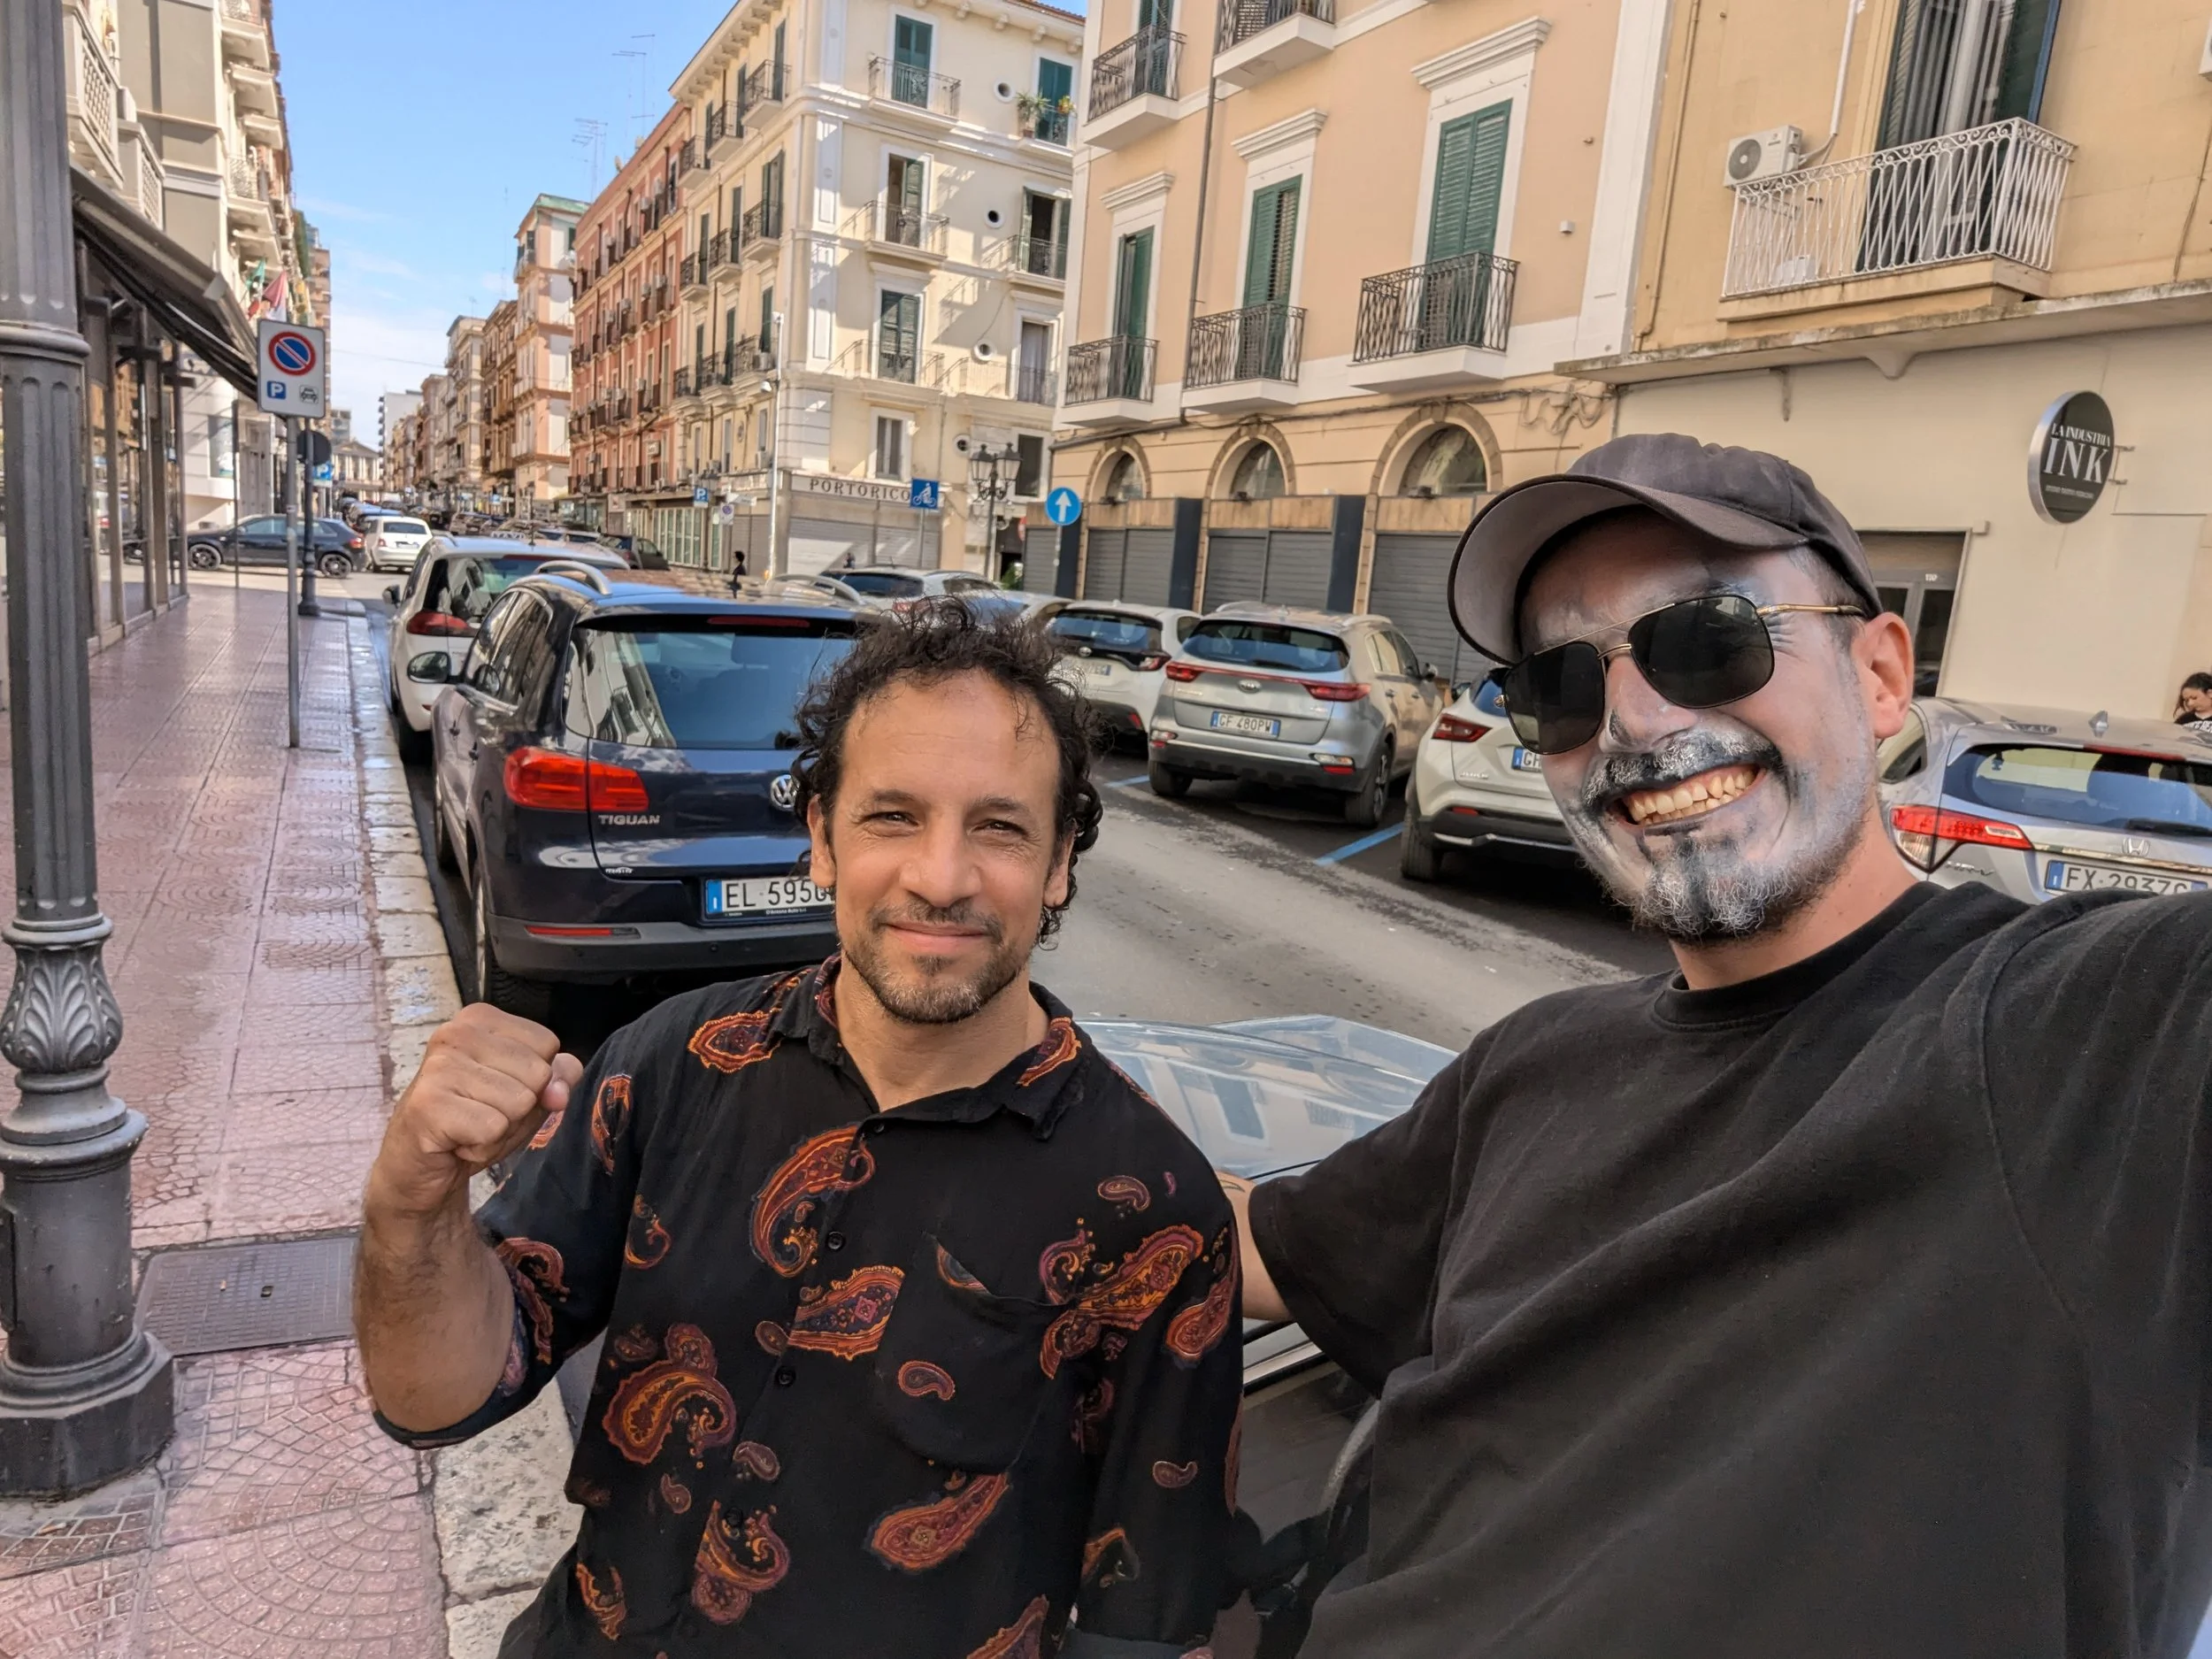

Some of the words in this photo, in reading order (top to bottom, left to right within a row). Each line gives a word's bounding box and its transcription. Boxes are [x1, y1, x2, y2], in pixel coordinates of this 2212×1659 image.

[271, 382, 283, 397] P
[2043, 437, 2109, 484] INK
[810, 478, 910, 502] PORTORICO
[597, 814, 661, 826] TIGUAN
[726, 882, 757, 909] EL
[767, 879, 830, 906] 595G
